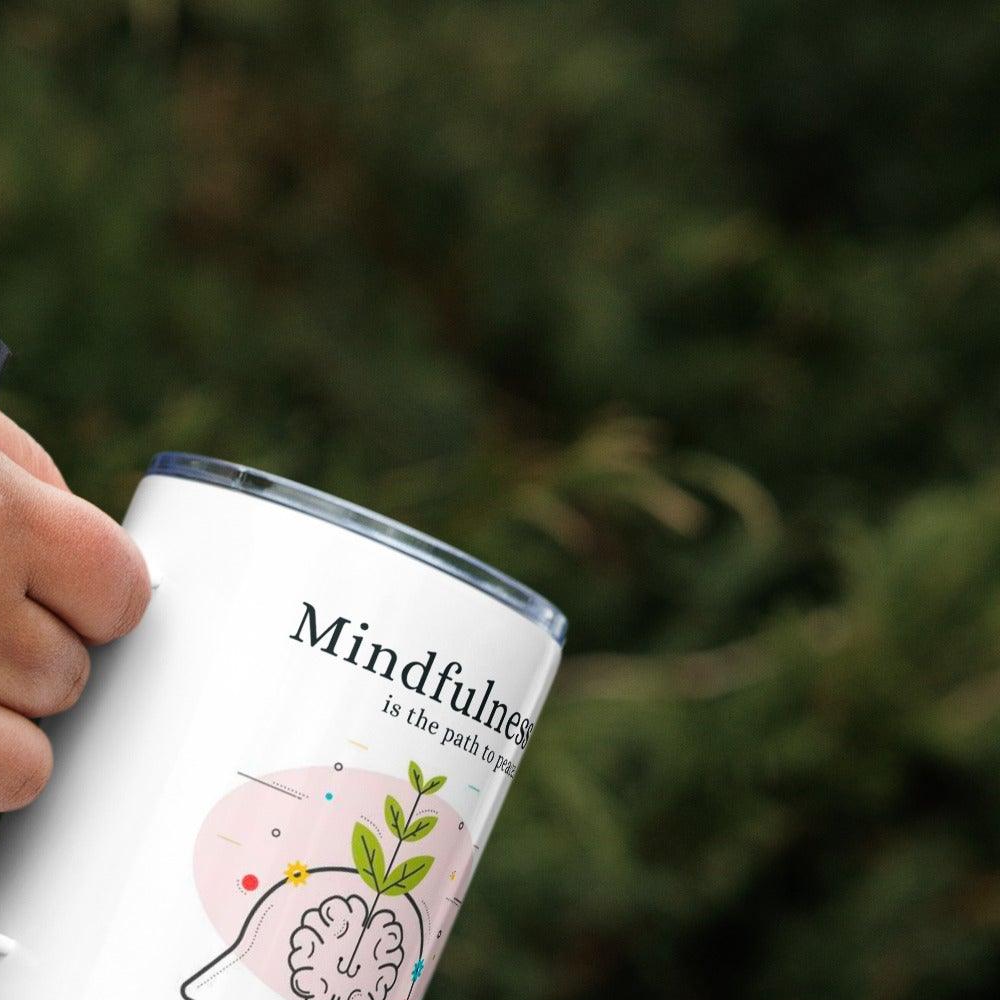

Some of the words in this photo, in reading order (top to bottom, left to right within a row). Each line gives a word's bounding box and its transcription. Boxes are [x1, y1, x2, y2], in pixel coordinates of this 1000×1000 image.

[289, 601, 535, 750] Mindfulness
[382, 694, 402, 717] is
[406, 708, 439, 735] the
[440, 727, 479, 756] path
[481, 745, 495, 764] to
